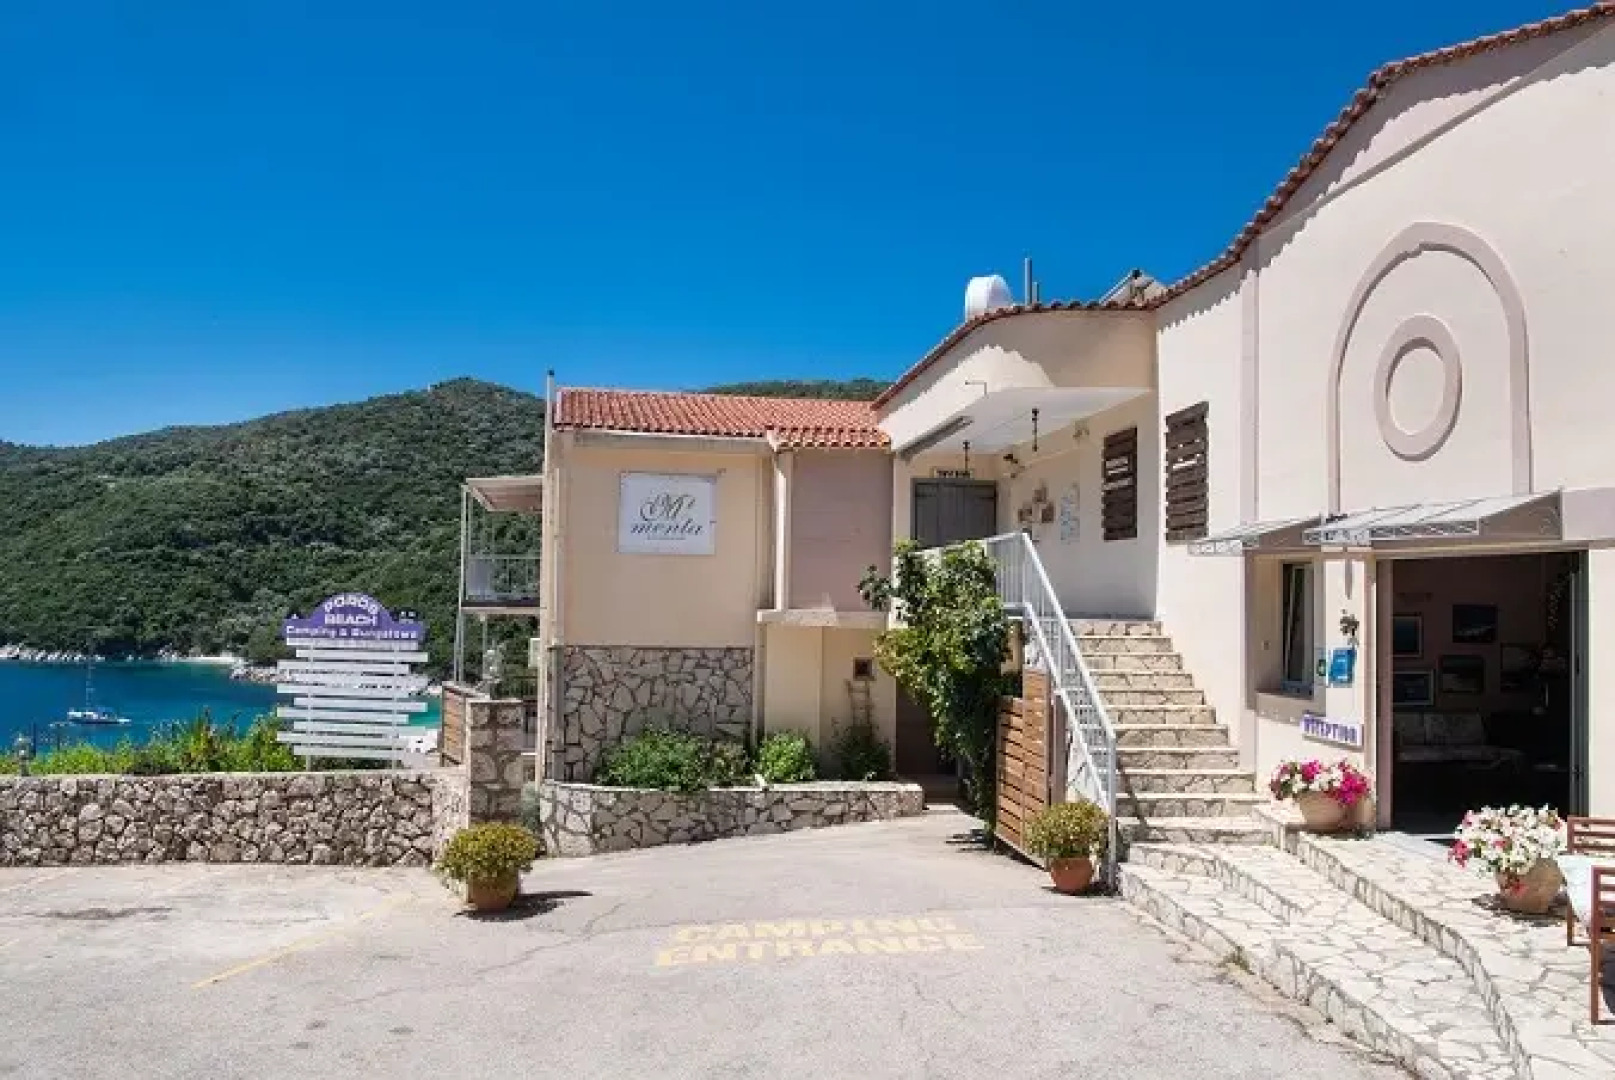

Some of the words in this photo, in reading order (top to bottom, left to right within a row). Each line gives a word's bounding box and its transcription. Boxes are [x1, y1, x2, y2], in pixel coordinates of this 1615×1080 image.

[286, 625, 338, 638] Camping
[324, 613, 379, 628] BEACH
[1303, 717, 1359, 744] RECEPTION
[671, 917, 957, 942] CAMPING
[656, 933, 985, 967] ENTRANCE
